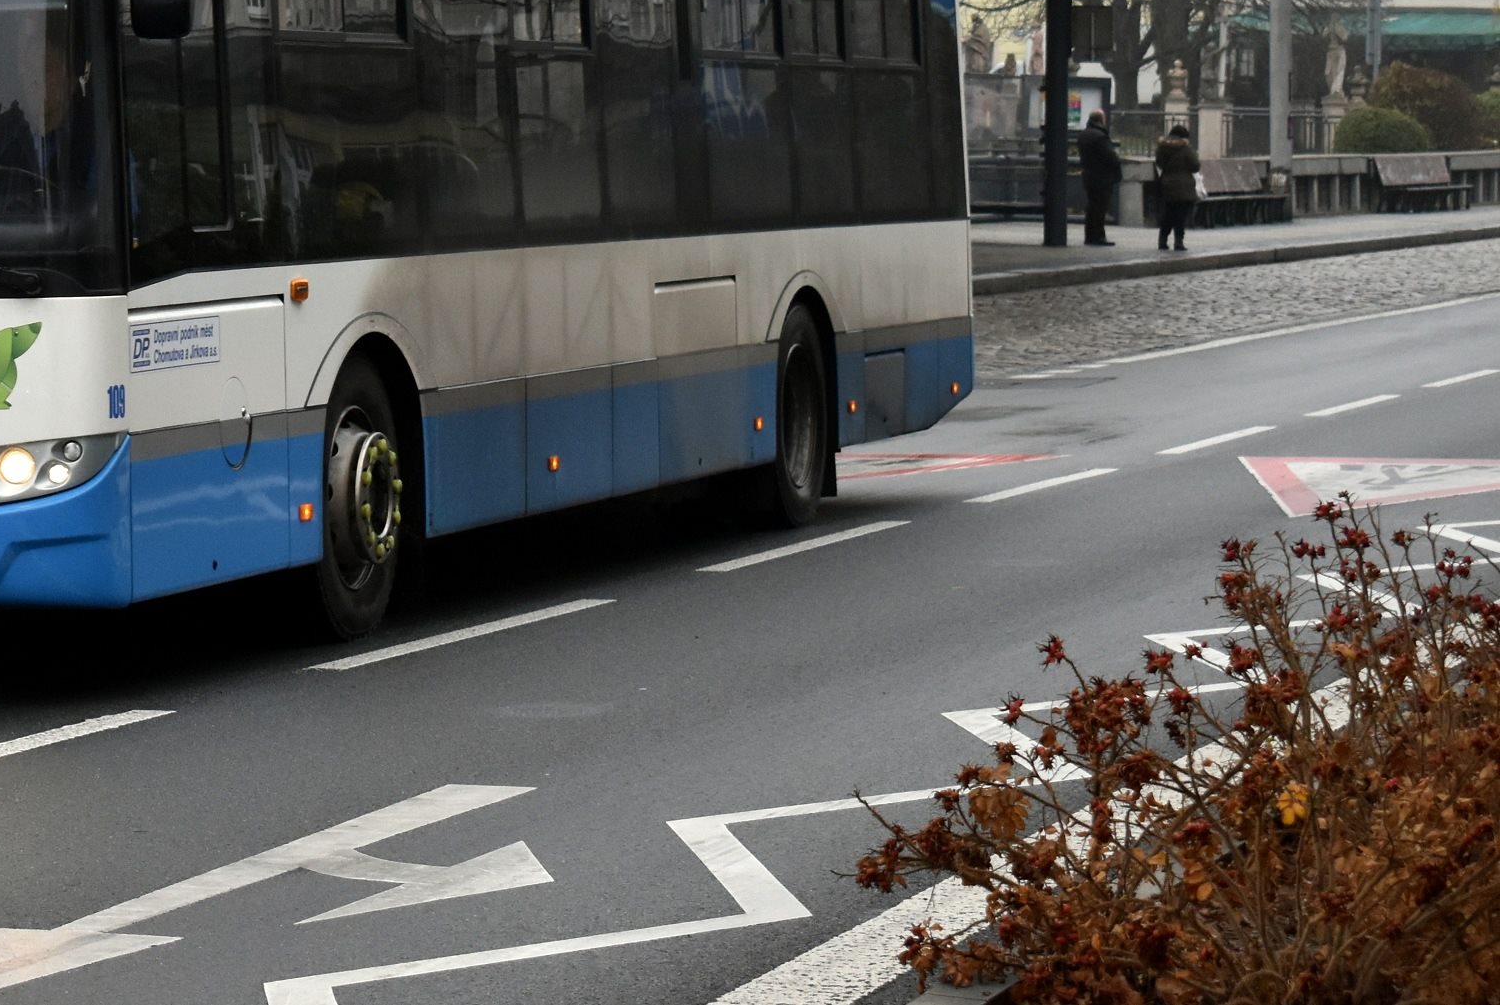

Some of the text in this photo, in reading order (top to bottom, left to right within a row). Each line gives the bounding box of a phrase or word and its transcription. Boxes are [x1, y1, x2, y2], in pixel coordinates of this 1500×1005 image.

[153, 324, 214, 345] Dopravní podnik měst
[133, 337, 151, 359] DP
[153, 347, 185, 364] Chomutova
[190, 344, 209, 359] Jirkova
[107, 384, 126, 419] 109
